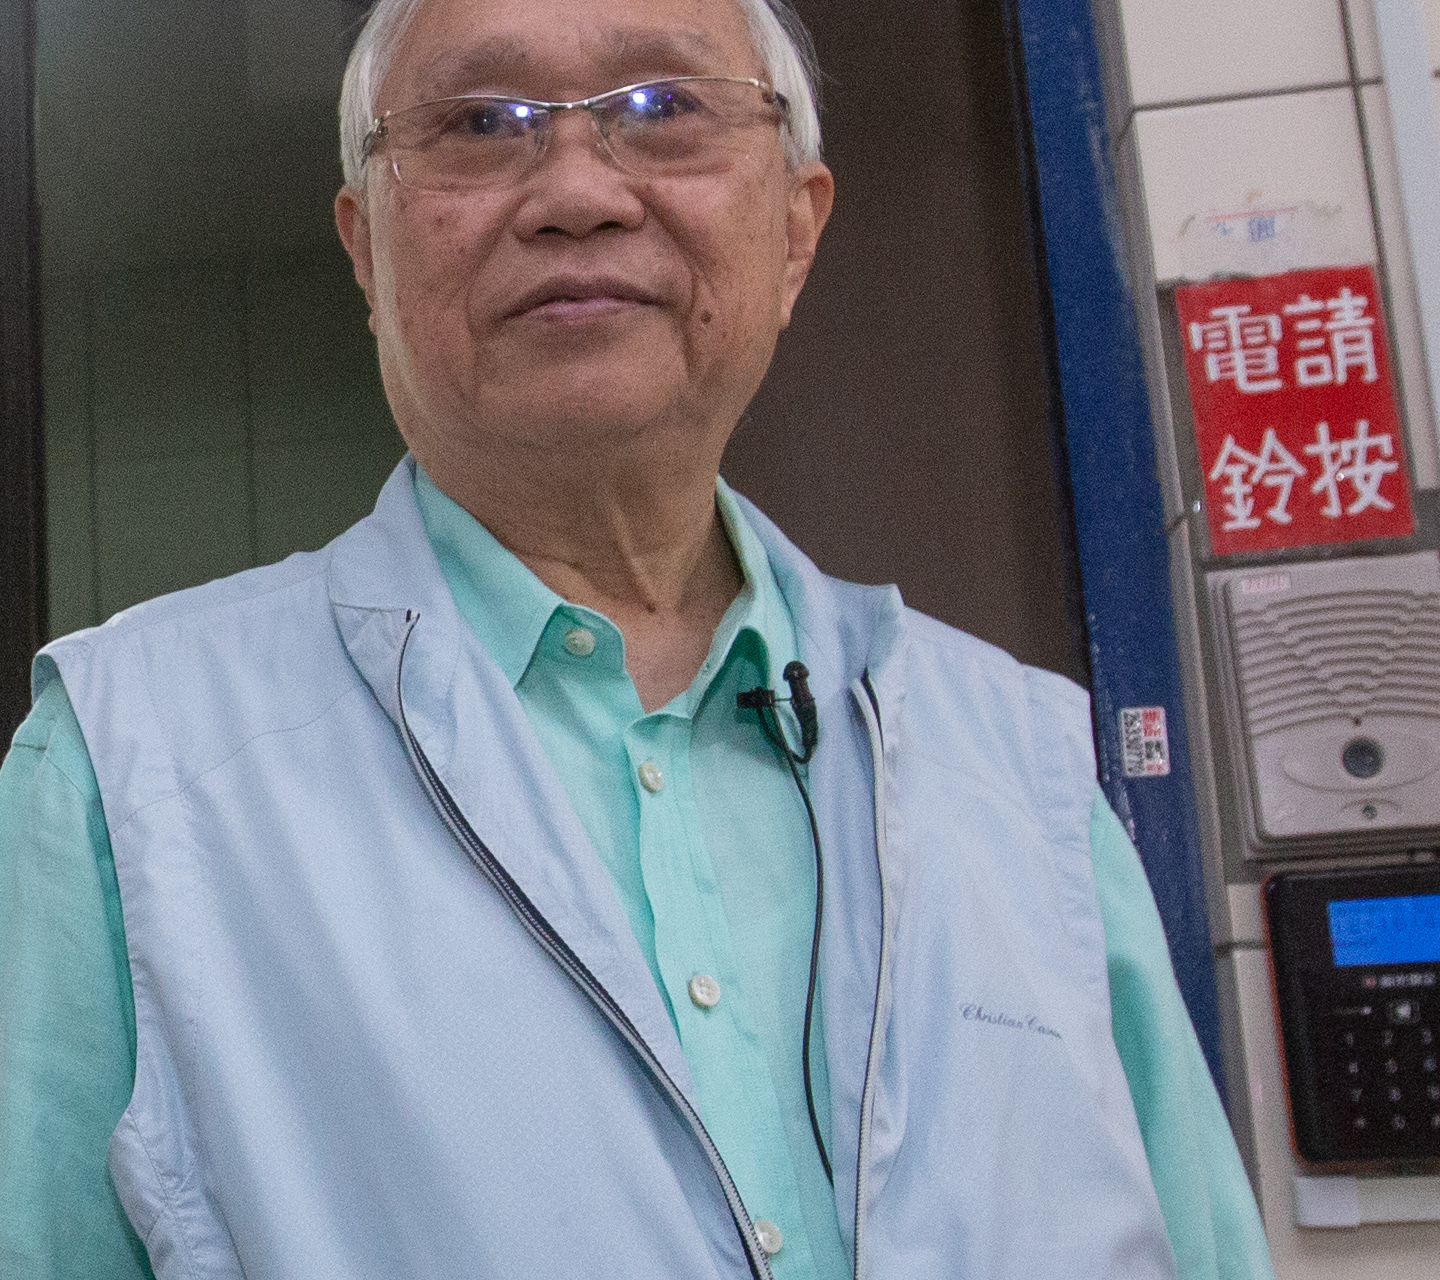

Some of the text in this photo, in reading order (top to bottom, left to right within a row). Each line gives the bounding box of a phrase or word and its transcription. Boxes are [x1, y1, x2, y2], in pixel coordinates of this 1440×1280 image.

[1188, 303, 1308, 533] 電鈴
[1282, 286, 1400, 519] 請按
[959, 1003, 1024, 1029] Christian
